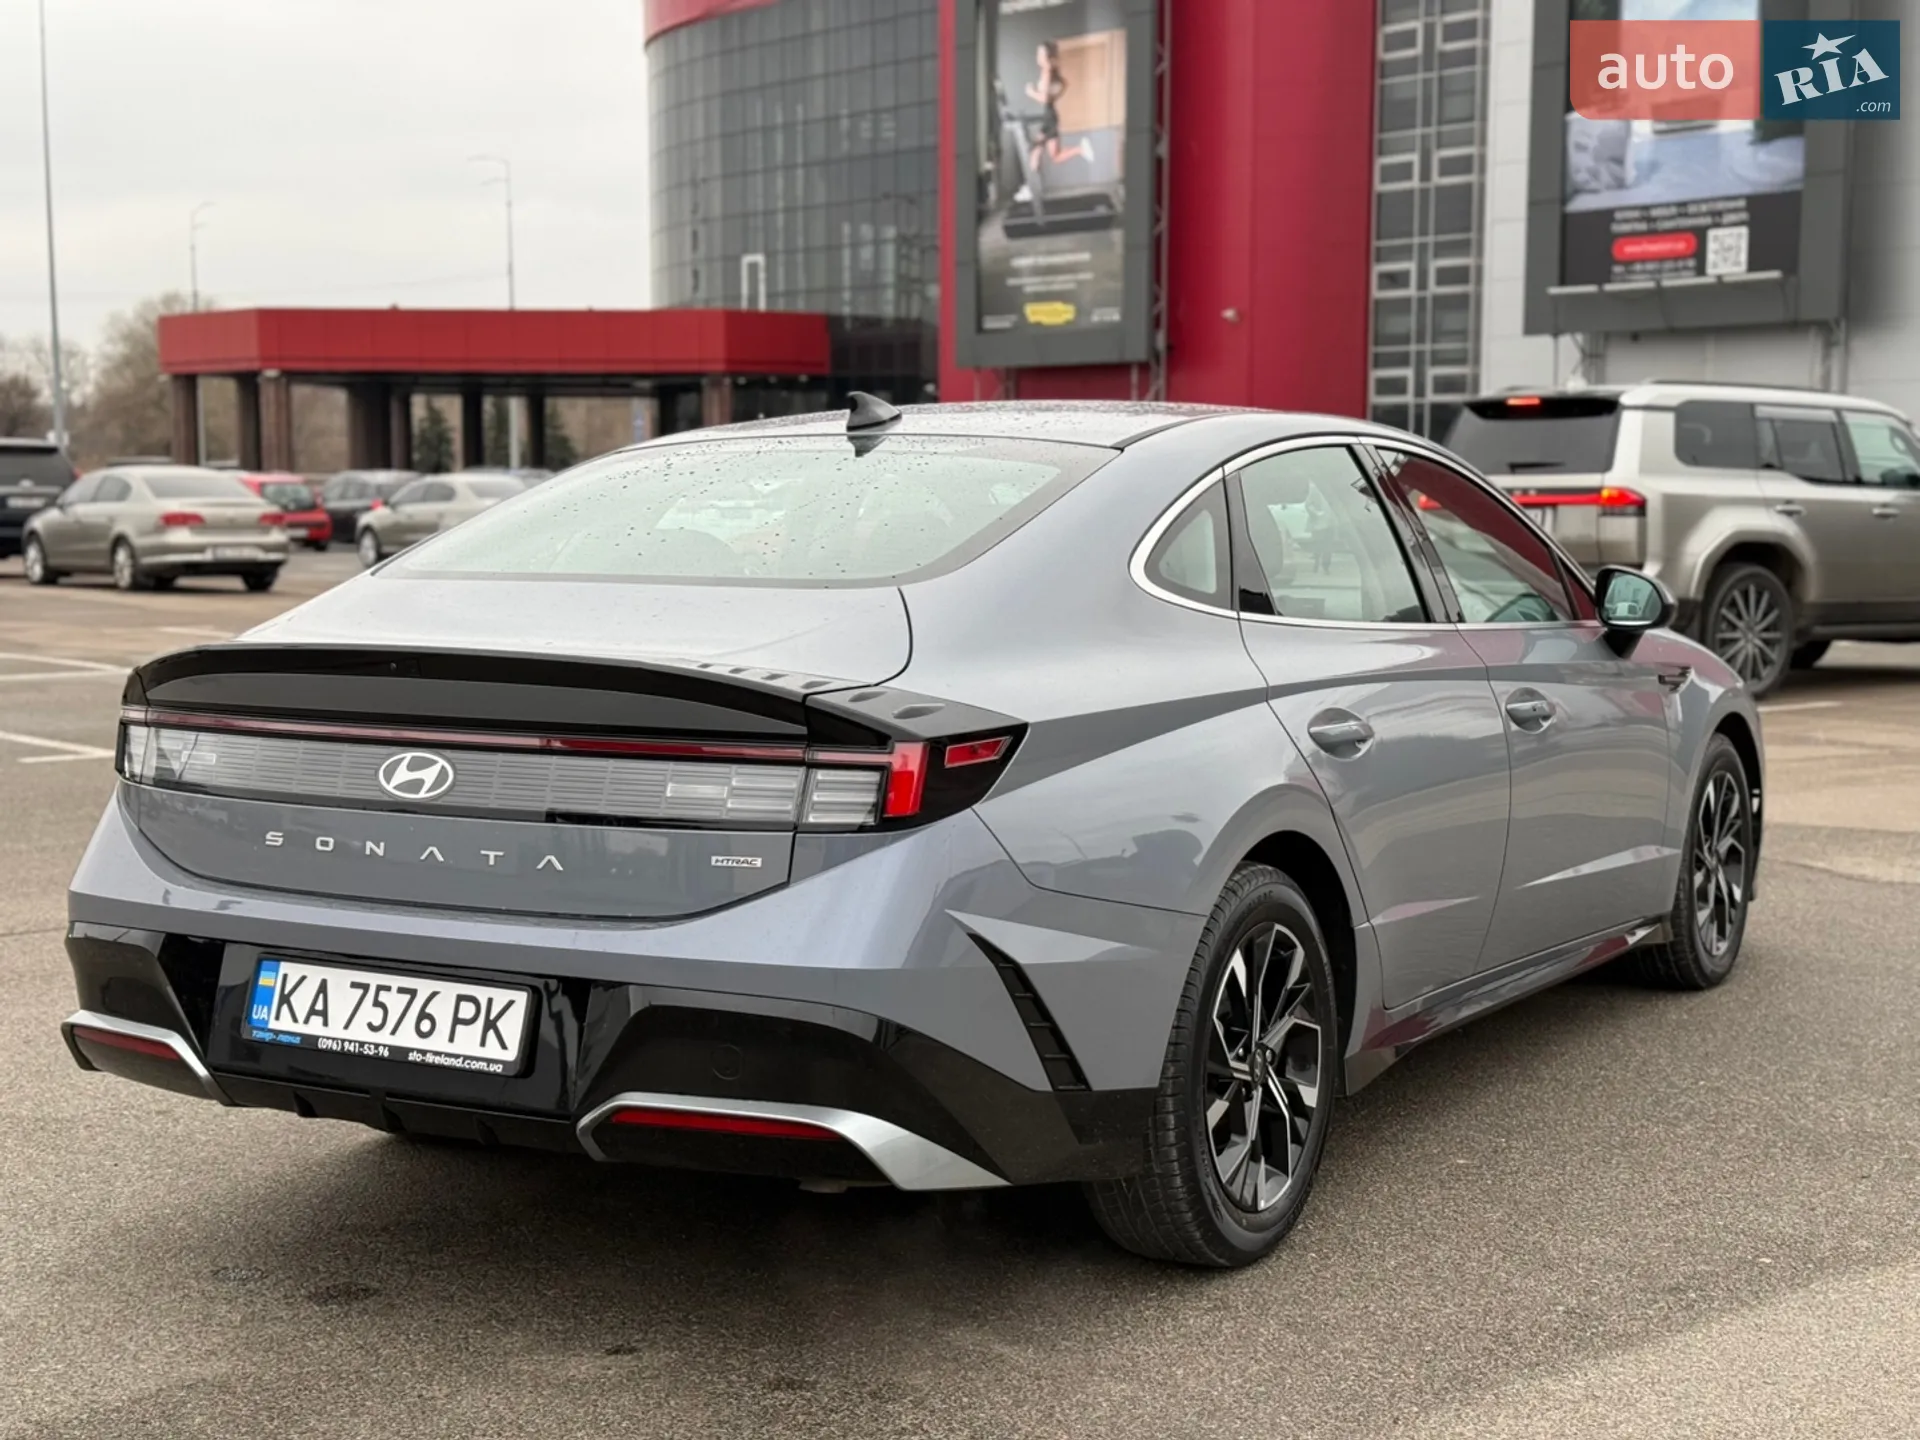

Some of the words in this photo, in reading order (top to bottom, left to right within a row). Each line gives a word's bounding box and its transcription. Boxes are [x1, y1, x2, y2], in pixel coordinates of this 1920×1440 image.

[265, 831, 564, 871] SONATA
[713, 857, 760, 867] HTRAC
[251, 1004, 269, 1020] UA
[274, 973, 330, 1028] KA
[343, 981, 441, 1039] 7576
[448, 994, 516, 1051] PK
[318, 1037, 342, 1051] (096)
[343, 1041, 390, 1058] 941-53-96
[408, 1051, 503, 1073] sto-tireland.com.ua
